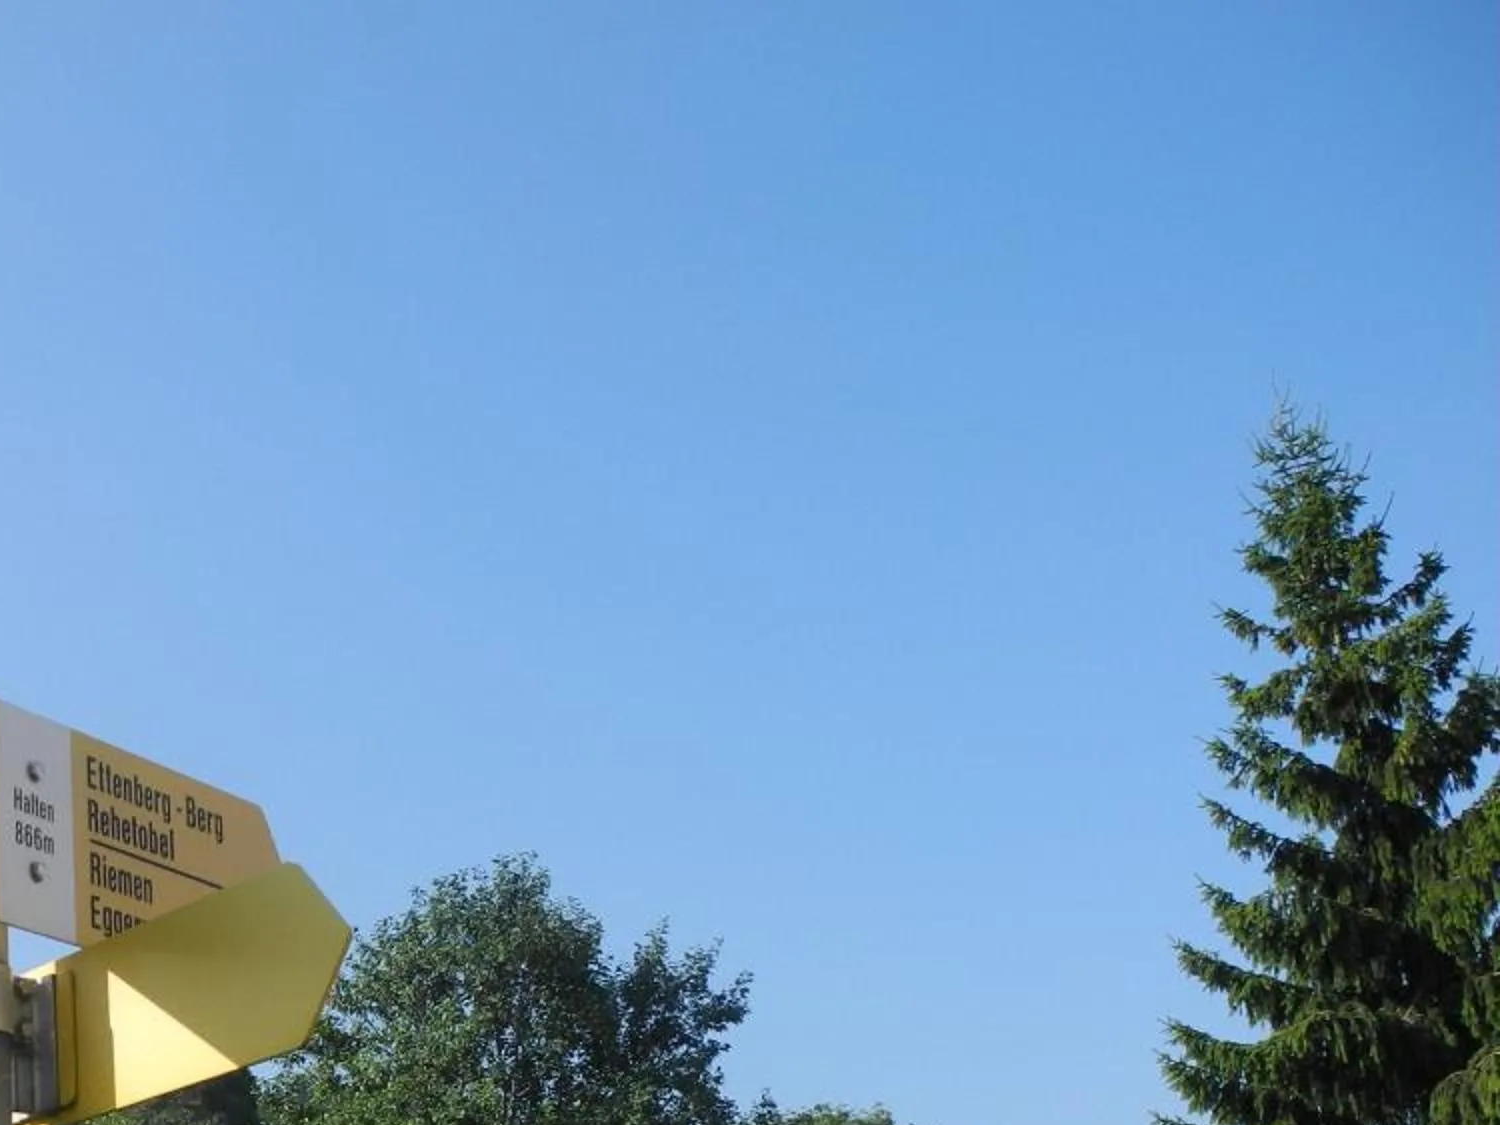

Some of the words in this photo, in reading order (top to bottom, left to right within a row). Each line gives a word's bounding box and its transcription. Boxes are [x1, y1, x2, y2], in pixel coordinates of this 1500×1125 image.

[15, 820, 55, 857] 866m
[88, 798, 175, 861] Rehetobel
[186, 796, 223, 844] Berg
[90, 852, 153, 905] Riemen
